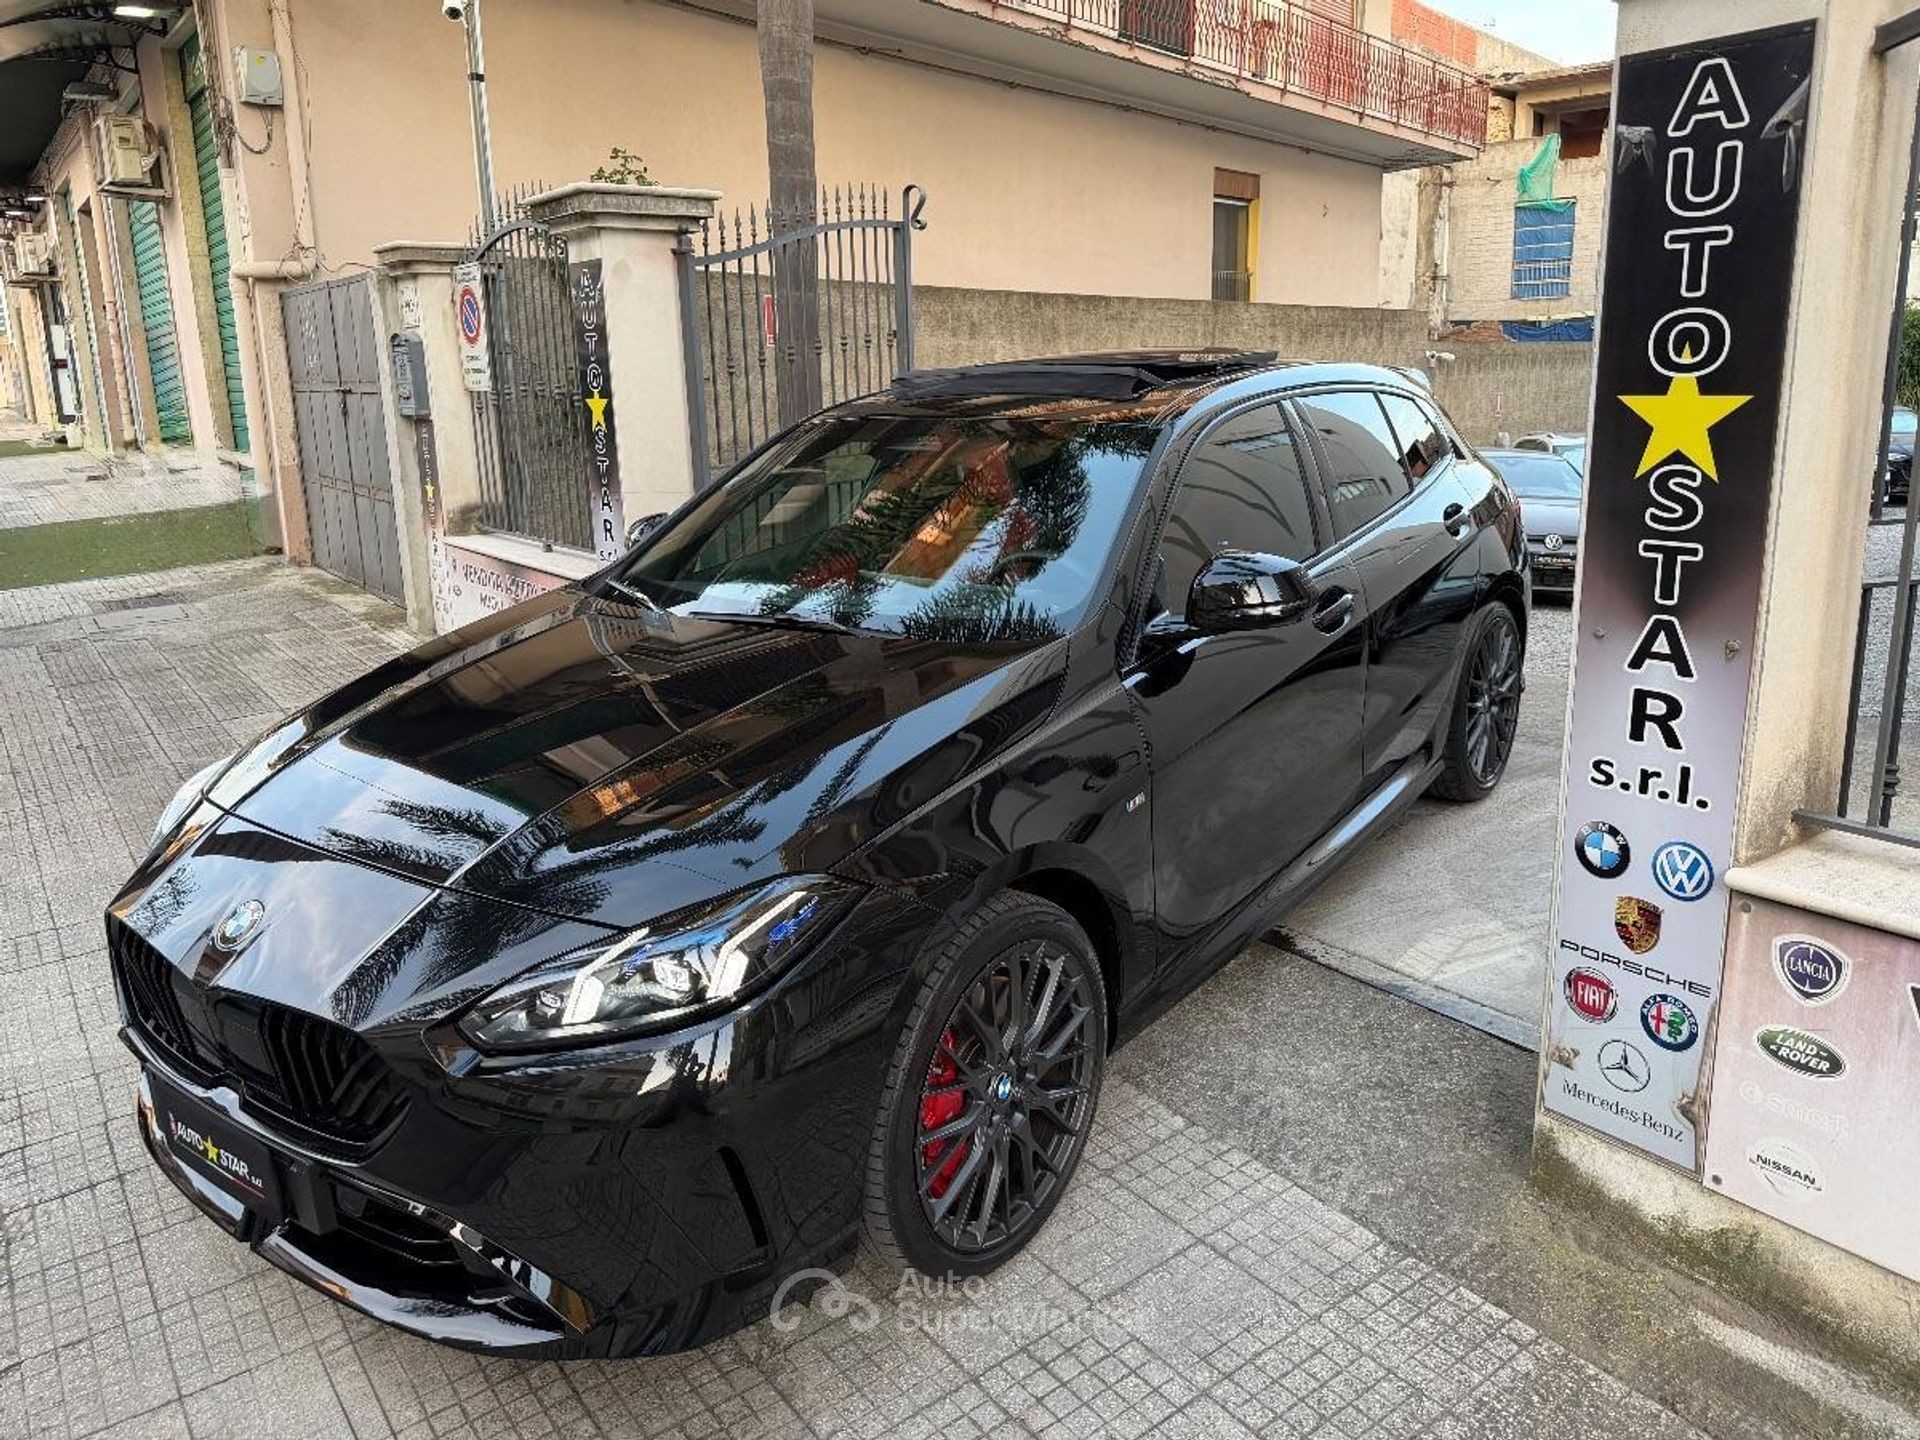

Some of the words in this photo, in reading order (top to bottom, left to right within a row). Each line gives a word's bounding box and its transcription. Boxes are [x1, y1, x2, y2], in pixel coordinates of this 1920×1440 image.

[1648, 57, 1750, 377] AUTO
[579, 268, 603, 391] AUTO
[594, 424, 615, 542] STAR
[1625, 464, 1704, 752] STAR
[1588, 756, 1710, 811] s.r.l.
[1560, 938, 1712, 998] PORSCHE
[1577, 981, 1608, 1010] FIAT
[1789, 956, 1830, 981] LANCIA
[1775, 1033, 1818, 1057] LAND
[1777, 1045, 1831, 1073] ROVER
[1563, 1077, 1684, 1142] Mercedes-Benz
[177, 1120, 205, 1151] AUTO
[219, 1148, 250, 1181] STAR
[1756, 1153, 1816, 1186] NISSAN
